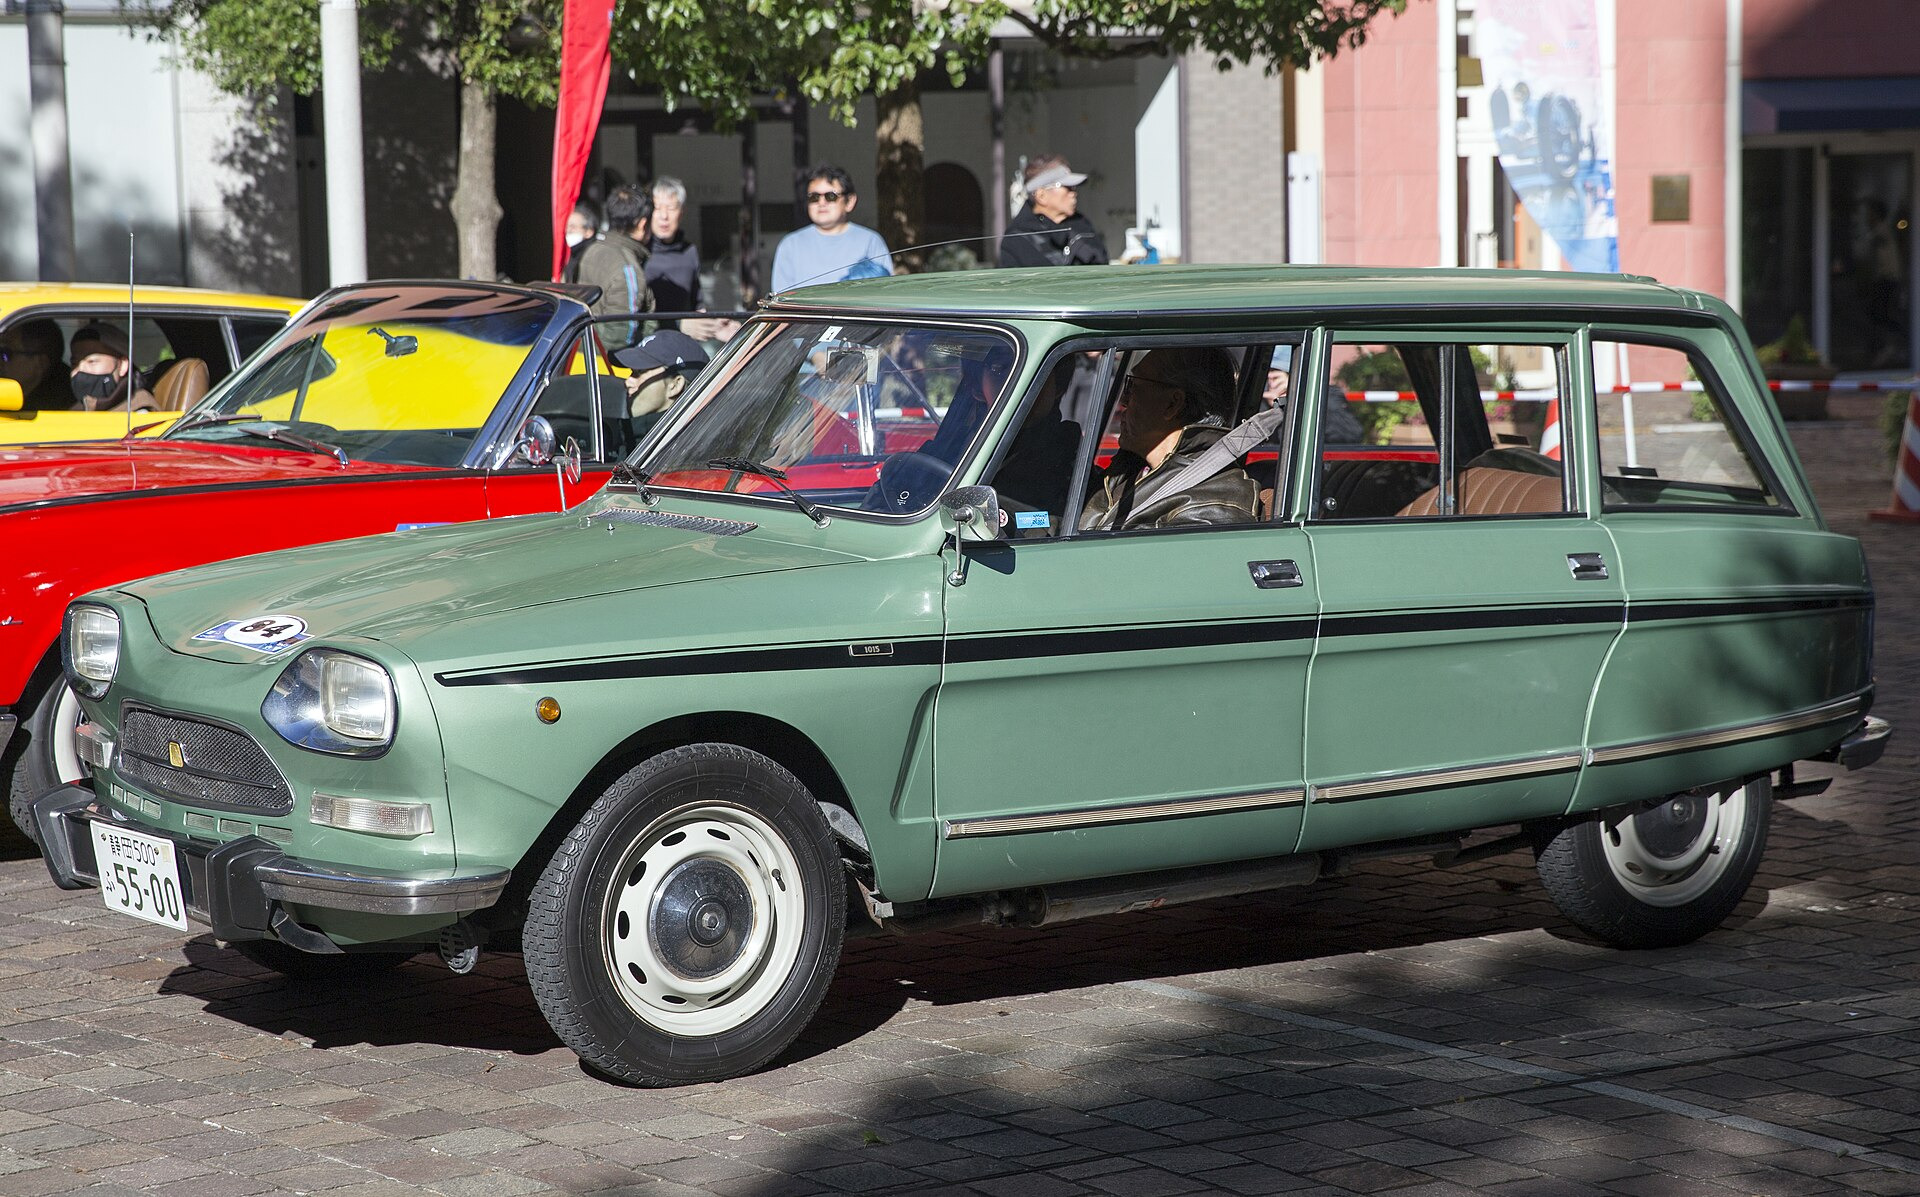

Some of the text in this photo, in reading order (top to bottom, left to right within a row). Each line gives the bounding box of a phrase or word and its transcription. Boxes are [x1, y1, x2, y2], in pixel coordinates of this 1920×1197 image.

[240, 619, 294, 638] 84
[864, 645, 880, 654] 1015
[113, 862, 180, 922] 55-00
